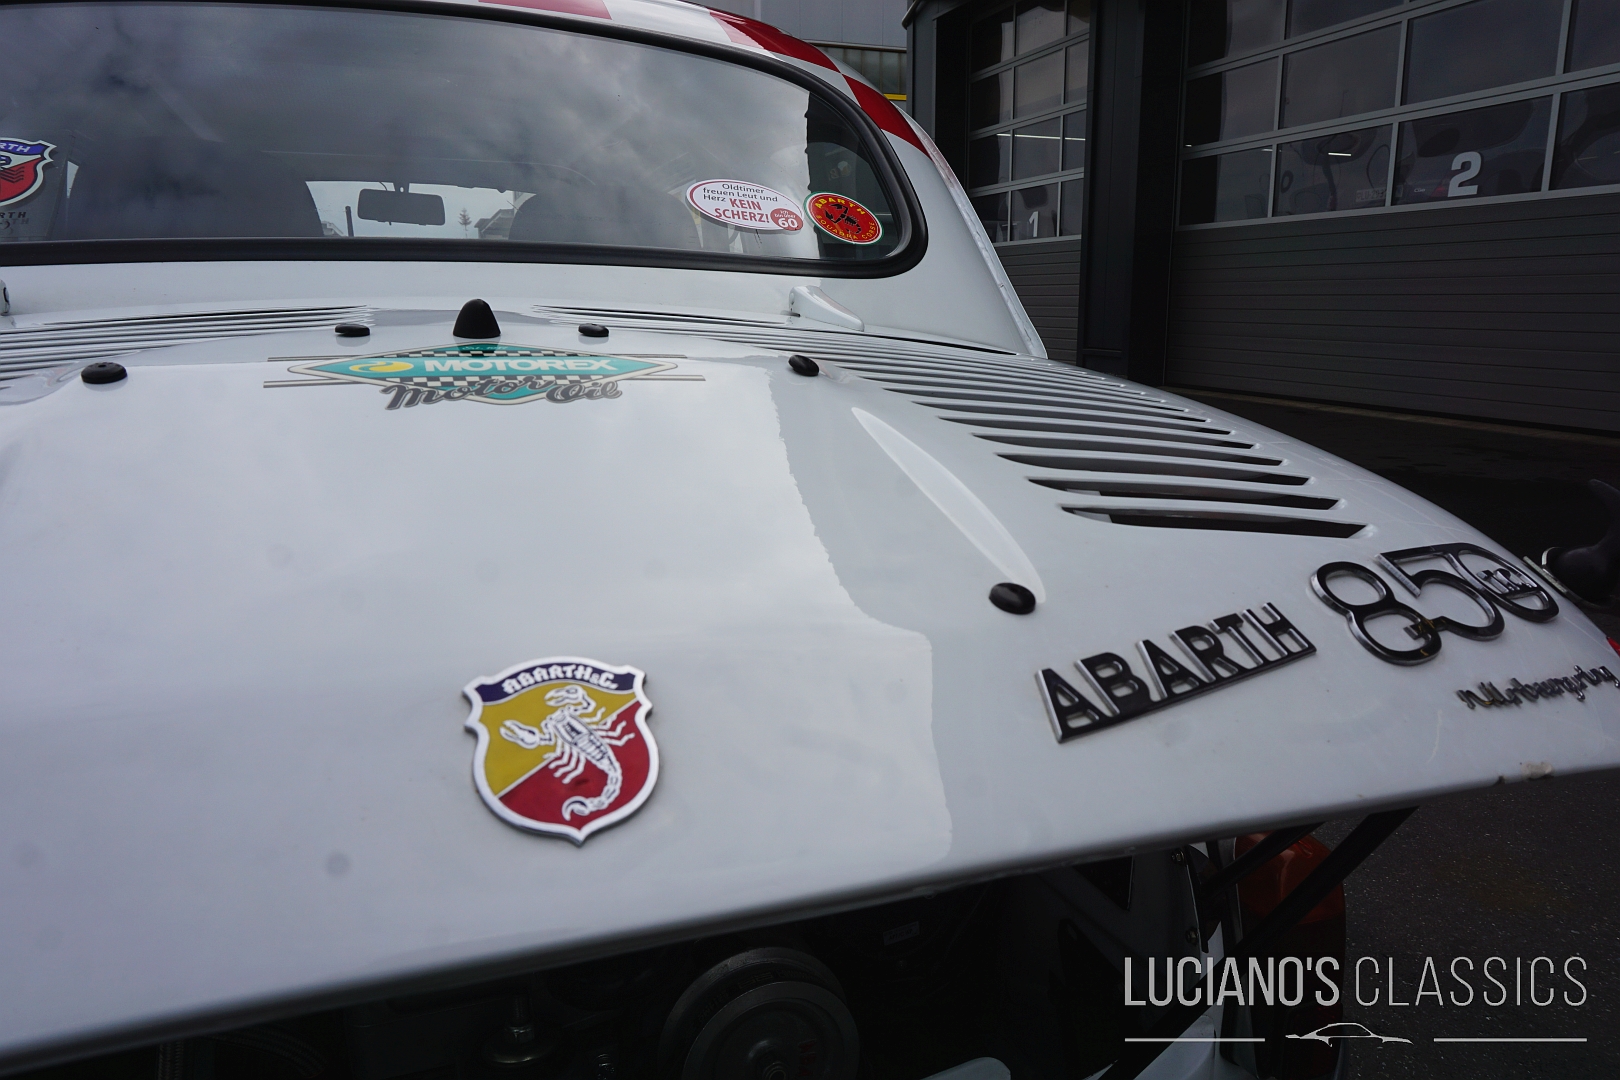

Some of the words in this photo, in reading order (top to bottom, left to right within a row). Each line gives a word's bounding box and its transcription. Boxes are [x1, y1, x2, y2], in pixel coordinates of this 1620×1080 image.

[1447, 151, 1482, 197] 2
[703, 187, 736, 198] freuen
[737, 191, 758, 200] Leut
[759, 195, 779, 203] und
[722, 183, 765, 194] Oldtimer
[703, 193, 727, 203] Herz
[729, 198, 763, 211] KEIN
[815, 197, 866, 215] ABARTH
[714, 208, 770, 223] SCHERZ!
[778, 217, 798, 228] 60
[1028, 210, 1039, 238] 1
[424, 359, 619, 371] MOTOREX
[380, 375, 557, 410] Motor
[546, 379, 623, 404] Oil
[1309, 542, 1560, 666] 850
[1035, 603, 1317, 743] ABARTH
